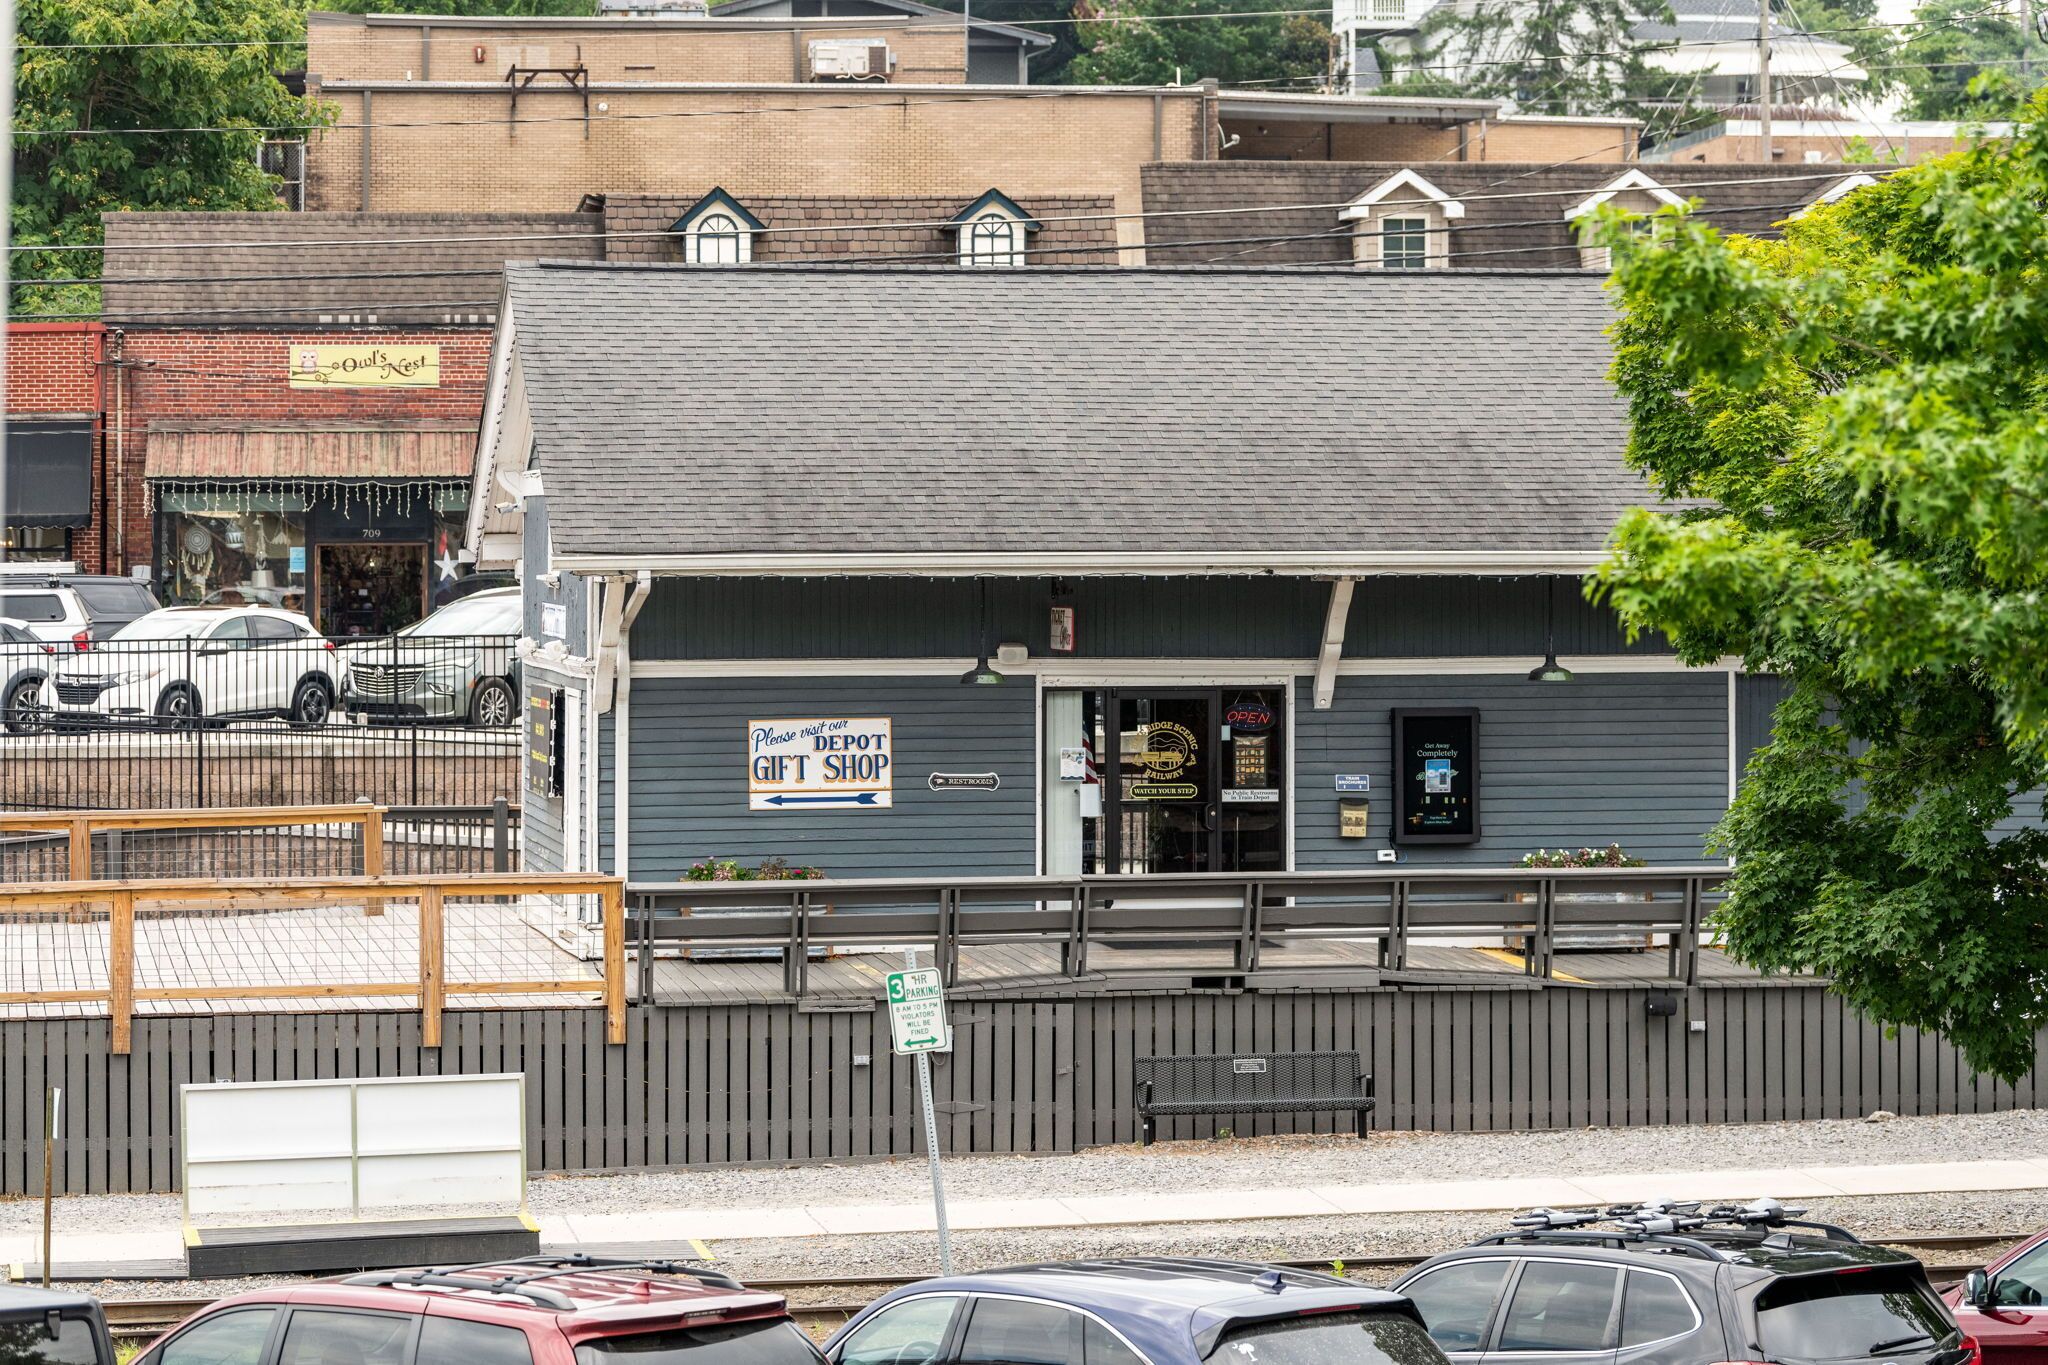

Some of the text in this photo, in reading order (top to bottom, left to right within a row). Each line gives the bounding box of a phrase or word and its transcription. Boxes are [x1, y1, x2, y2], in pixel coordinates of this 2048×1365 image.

[342, 349, 427, 380] Owl's Nest
[362, 529, 381, 538] 709
[1227, 710, 1271, 724] OPEN
[751, 720, 848, 752] Please visit our
[813, 734, 887, 752] DEPOT
[1174, 723, 1198, 750] SCENIC
[1417, 750, 1458, 758] Completely
[752, 754, 890, 784] GIFT SHOP
[1144, 768, 1184, 780] RAILWAY
[890, 974, 927, 998] 3 HR
[906, 986, 938, 998] PARKING
[901, 1010, 935, 1020] VIOLATORS
